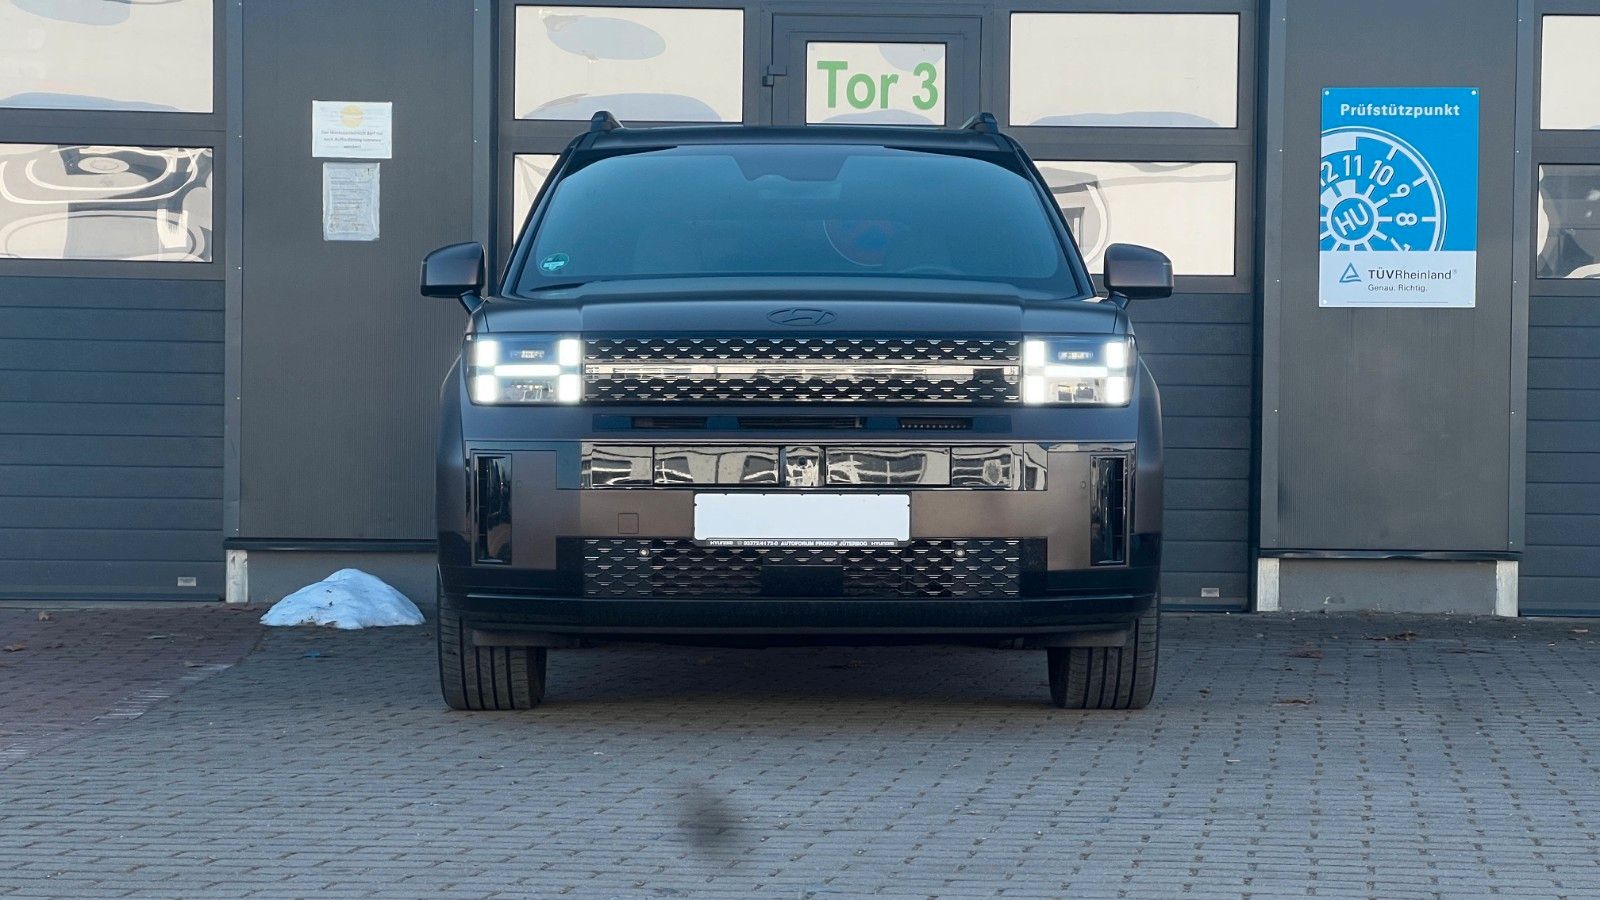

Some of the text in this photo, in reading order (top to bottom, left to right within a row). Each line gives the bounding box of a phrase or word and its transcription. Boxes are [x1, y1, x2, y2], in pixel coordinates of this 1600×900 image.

[817, 60, 938, 110] Tor 3
[1340, 103, 1460, 118] Prüfstützpunkt
[1342, 154, 1363, 177] 11
[1369, 159, 1395, 186] 10
[1389, 183, 1411, 198] 9
[1334, 202, 1369, 236] HU
[1395, 212, 1418, 226] 8
[1368, 284, 1428, 293] Genau. Richtig.
